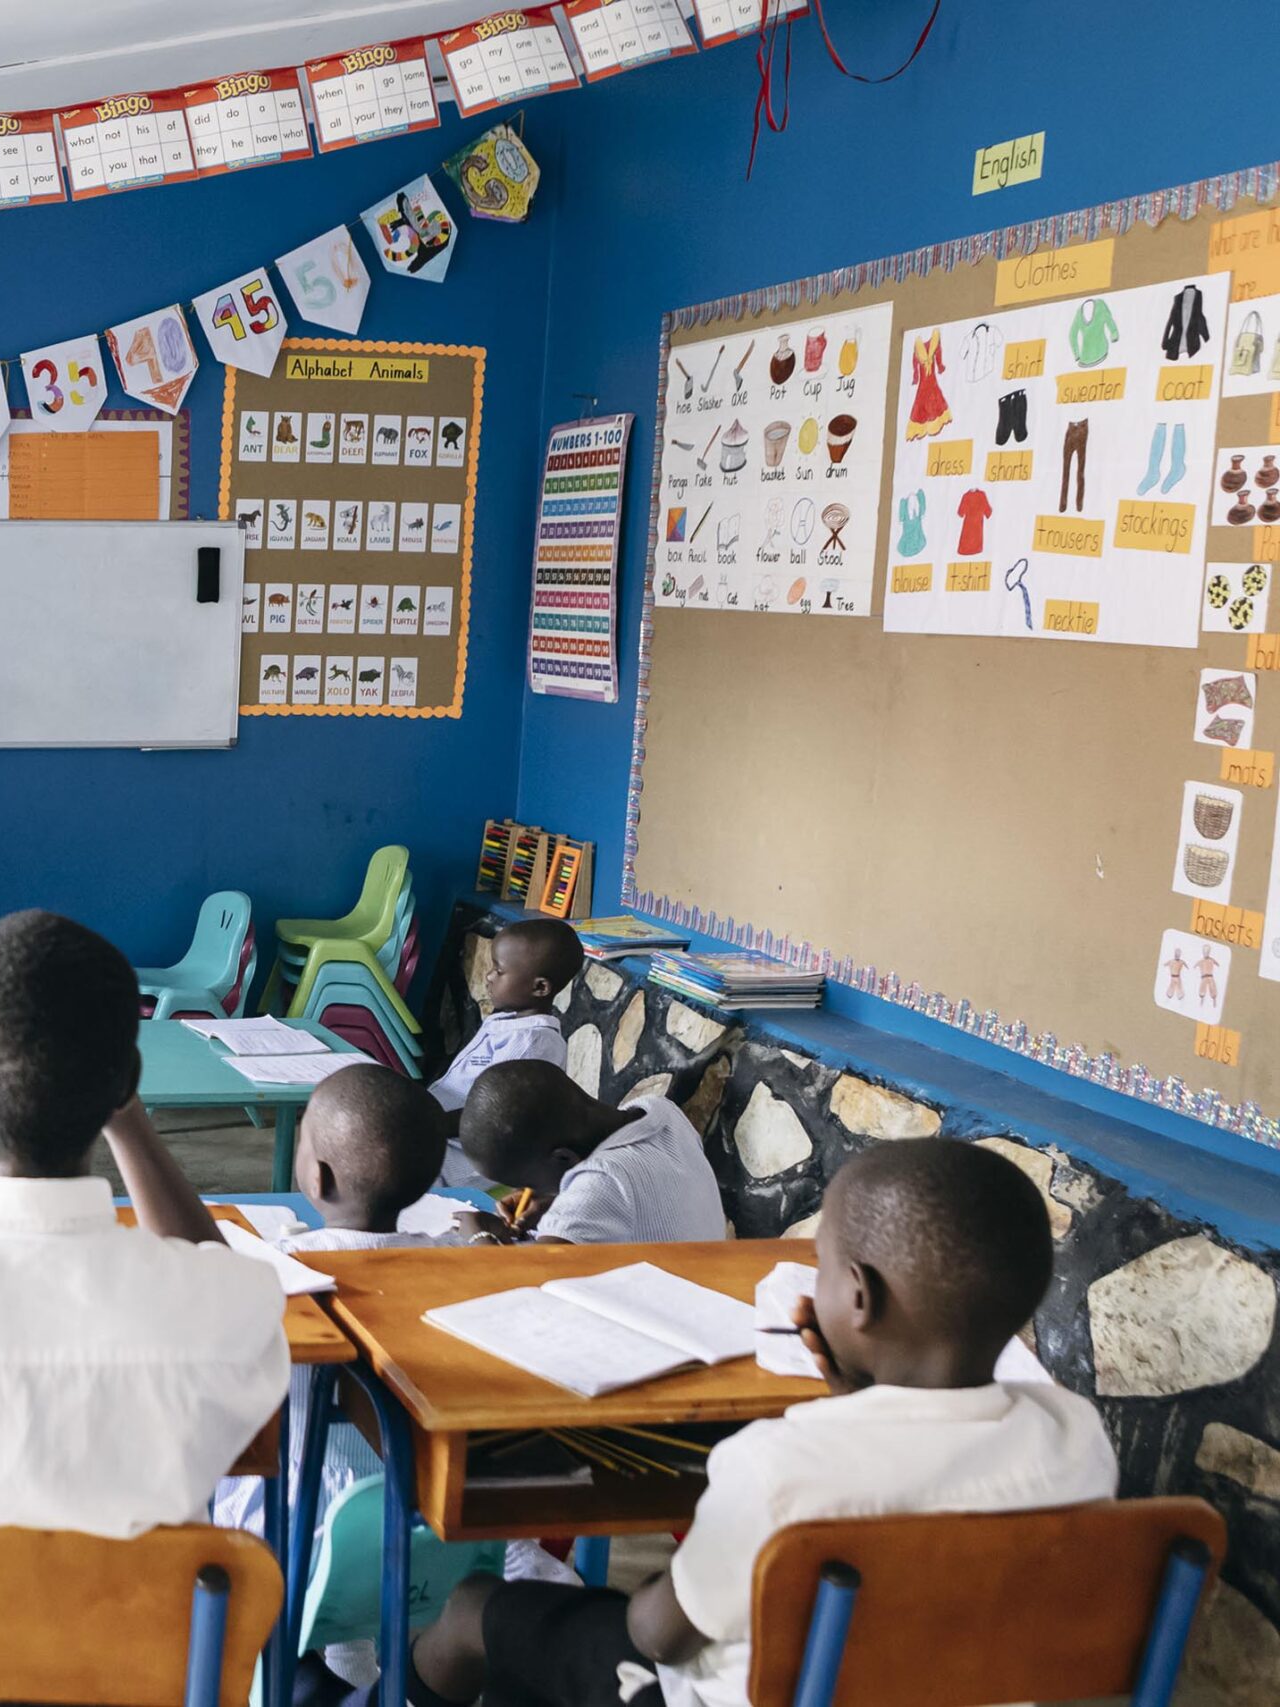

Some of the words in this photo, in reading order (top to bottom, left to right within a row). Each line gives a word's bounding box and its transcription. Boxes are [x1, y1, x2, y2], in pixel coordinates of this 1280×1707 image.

[344, 46, 394, 73] Bingo
[317, 88, 343, 100] when
[356, 83, 364, 91] in
[383, 77, 394, 88] go
[404, 71, 425, 81] some
[97, 96, 151, 121] Bingo
[330, 117, 341, 128] all
[355, 112, 375, 125] your
[384, 106, 403, 115] they
[410, 99, 430, 110] from
[70, 135, 95, 148] what
[105, 130, 120, 140] not
[136, 125, 150, 135] his
[167, 121, 175, 130] of
[81, 167, 94, 176] do
[109, 162, 127, 173] you
[139, 155, 157, 164] that
[173, 152, 181, 160] at
[980, 136, 1038, 188] English
[294, 242, 360, 310] 50
[1014, 253, 1079, 289] Clothes
[212, 279, 279, 340] 45
[126, 317, 186, 384] 40
[1007, 346, 1044, 380] shirt
[291, 358, 352, 379] Alphabet
[370, 362, 424, 380] Animals
[1162, 366, 1204, 401] coat
[32, 359, 98, 414] 35
[770, 385, 787, 399] Pot
[803, 380, 822, 401] Cup
[836, 377, 855, 398] Jug
[1061, 370, 1122, 403] sweater
[676, 402, 691, 415] hoe
[732, 392, 747, 406] axe
[242, 444, 263, 454] ANT
[341, 448, 364, 456] DEER
[409, 450, 428, 459] FOX
[551, 432, 591, 452] NUMBERS
[595, 429, 622, 445] 1-100
[930, 442, 965, 476] dress
[989, 453, 1030, 481] shorts
[723, 474, 738, 486] hut
[761, 466, 785, 482] basket
[826, 464, 847, 478] drum
[337, 536, 358, 544] KOALA
[370, 536, 390, 544] LAMB
[1037, 520, 1100, 551] trousers
[1120, 503, 1188, 553] stockings
[668, 550, 682, 562] box
[718, 551, 736, 564] book
[756, 549, 780, 562] flower
[790, 550, 806, 564] ball
[894, 565, 931, 591] blouse
[675, 588, 686, 607] bag
[800, 599, 811, 613] egg
[837, 597, 854, 611] Tree
[270, 615, 285, 623] PIG
[1048, 601, 1095, 633] necktie
[327, 687, 350, 696] XOLO
[360, 688, 378, 697] YAK
[1227, 752, 1266, 788] mats
[1195, 899, 1254, 948] baskets
[1199, 1025, 1232, 1064] dolls
